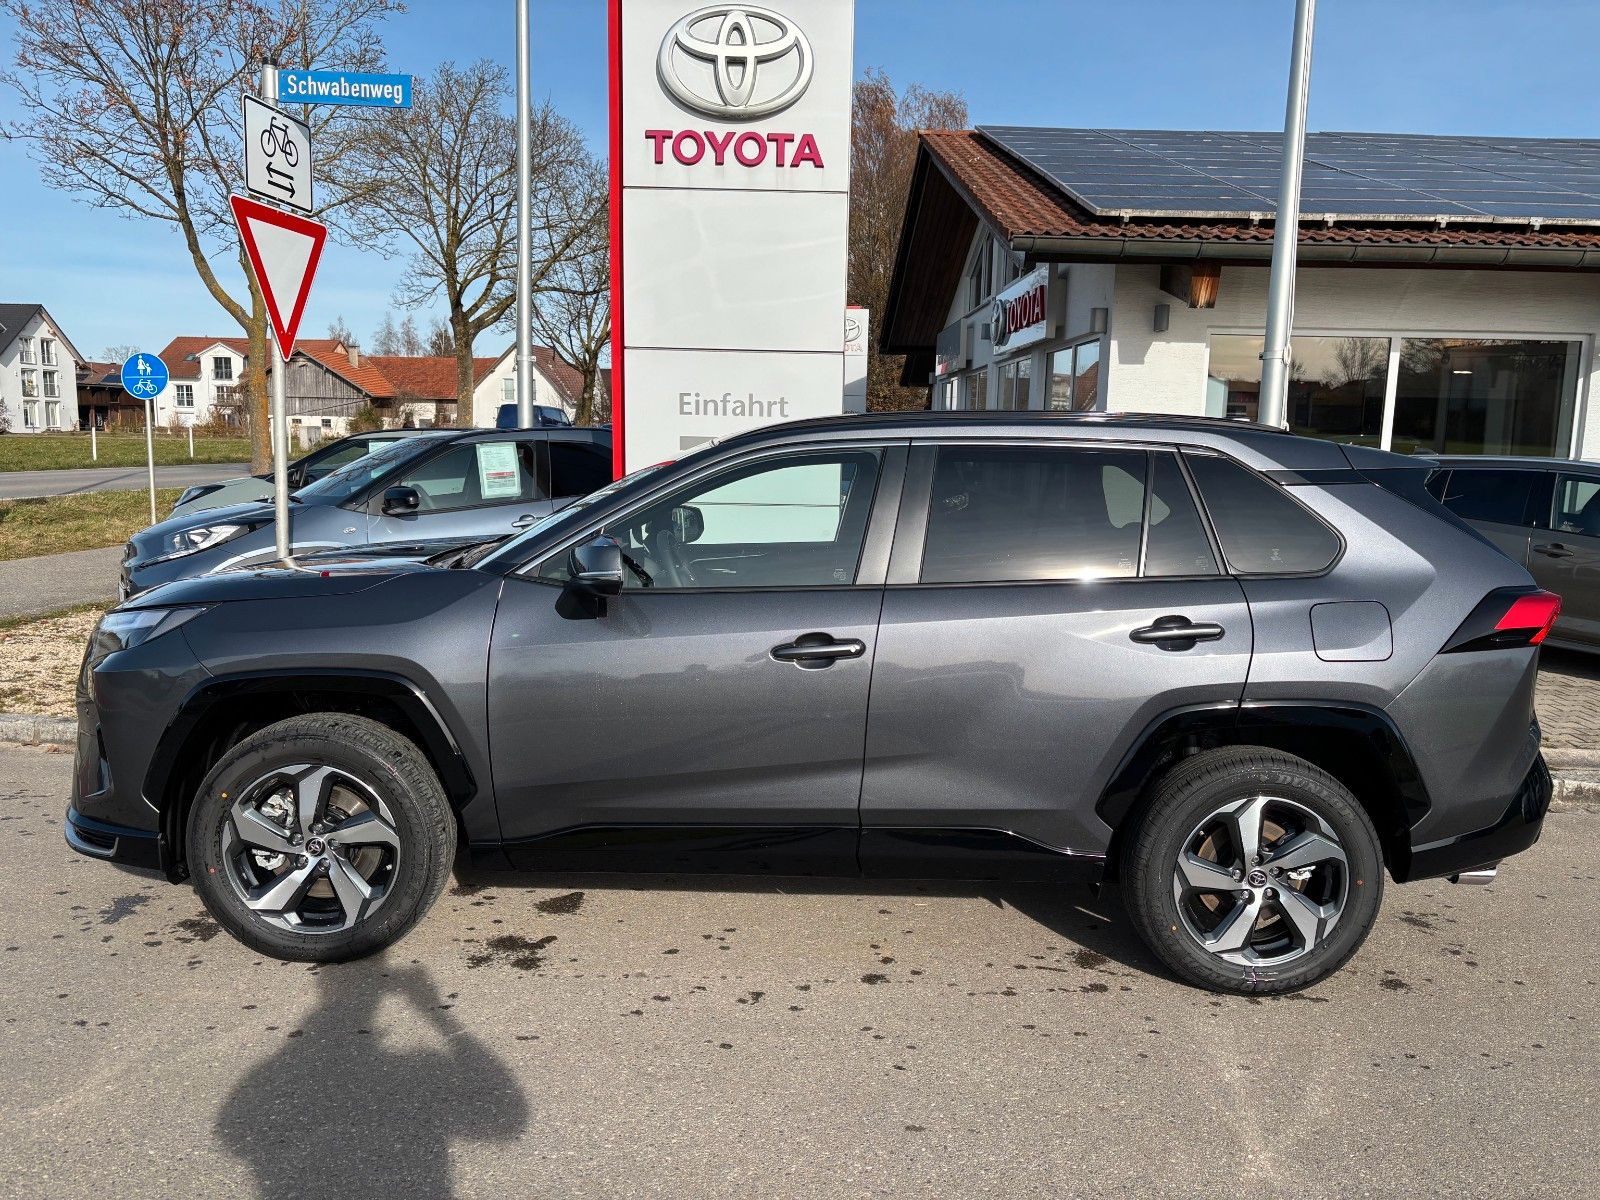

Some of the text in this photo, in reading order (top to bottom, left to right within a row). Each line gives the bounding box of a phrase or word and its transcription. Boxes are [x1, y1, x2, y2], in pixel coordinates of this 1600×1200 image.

[287, 74, 403, 104] Schwabenweg
[645, 130, 824, 168] TOYOTA
[1006, 287, 1045, 333] TOYOTA
[679, 392, 788, 418] Einfahrt
